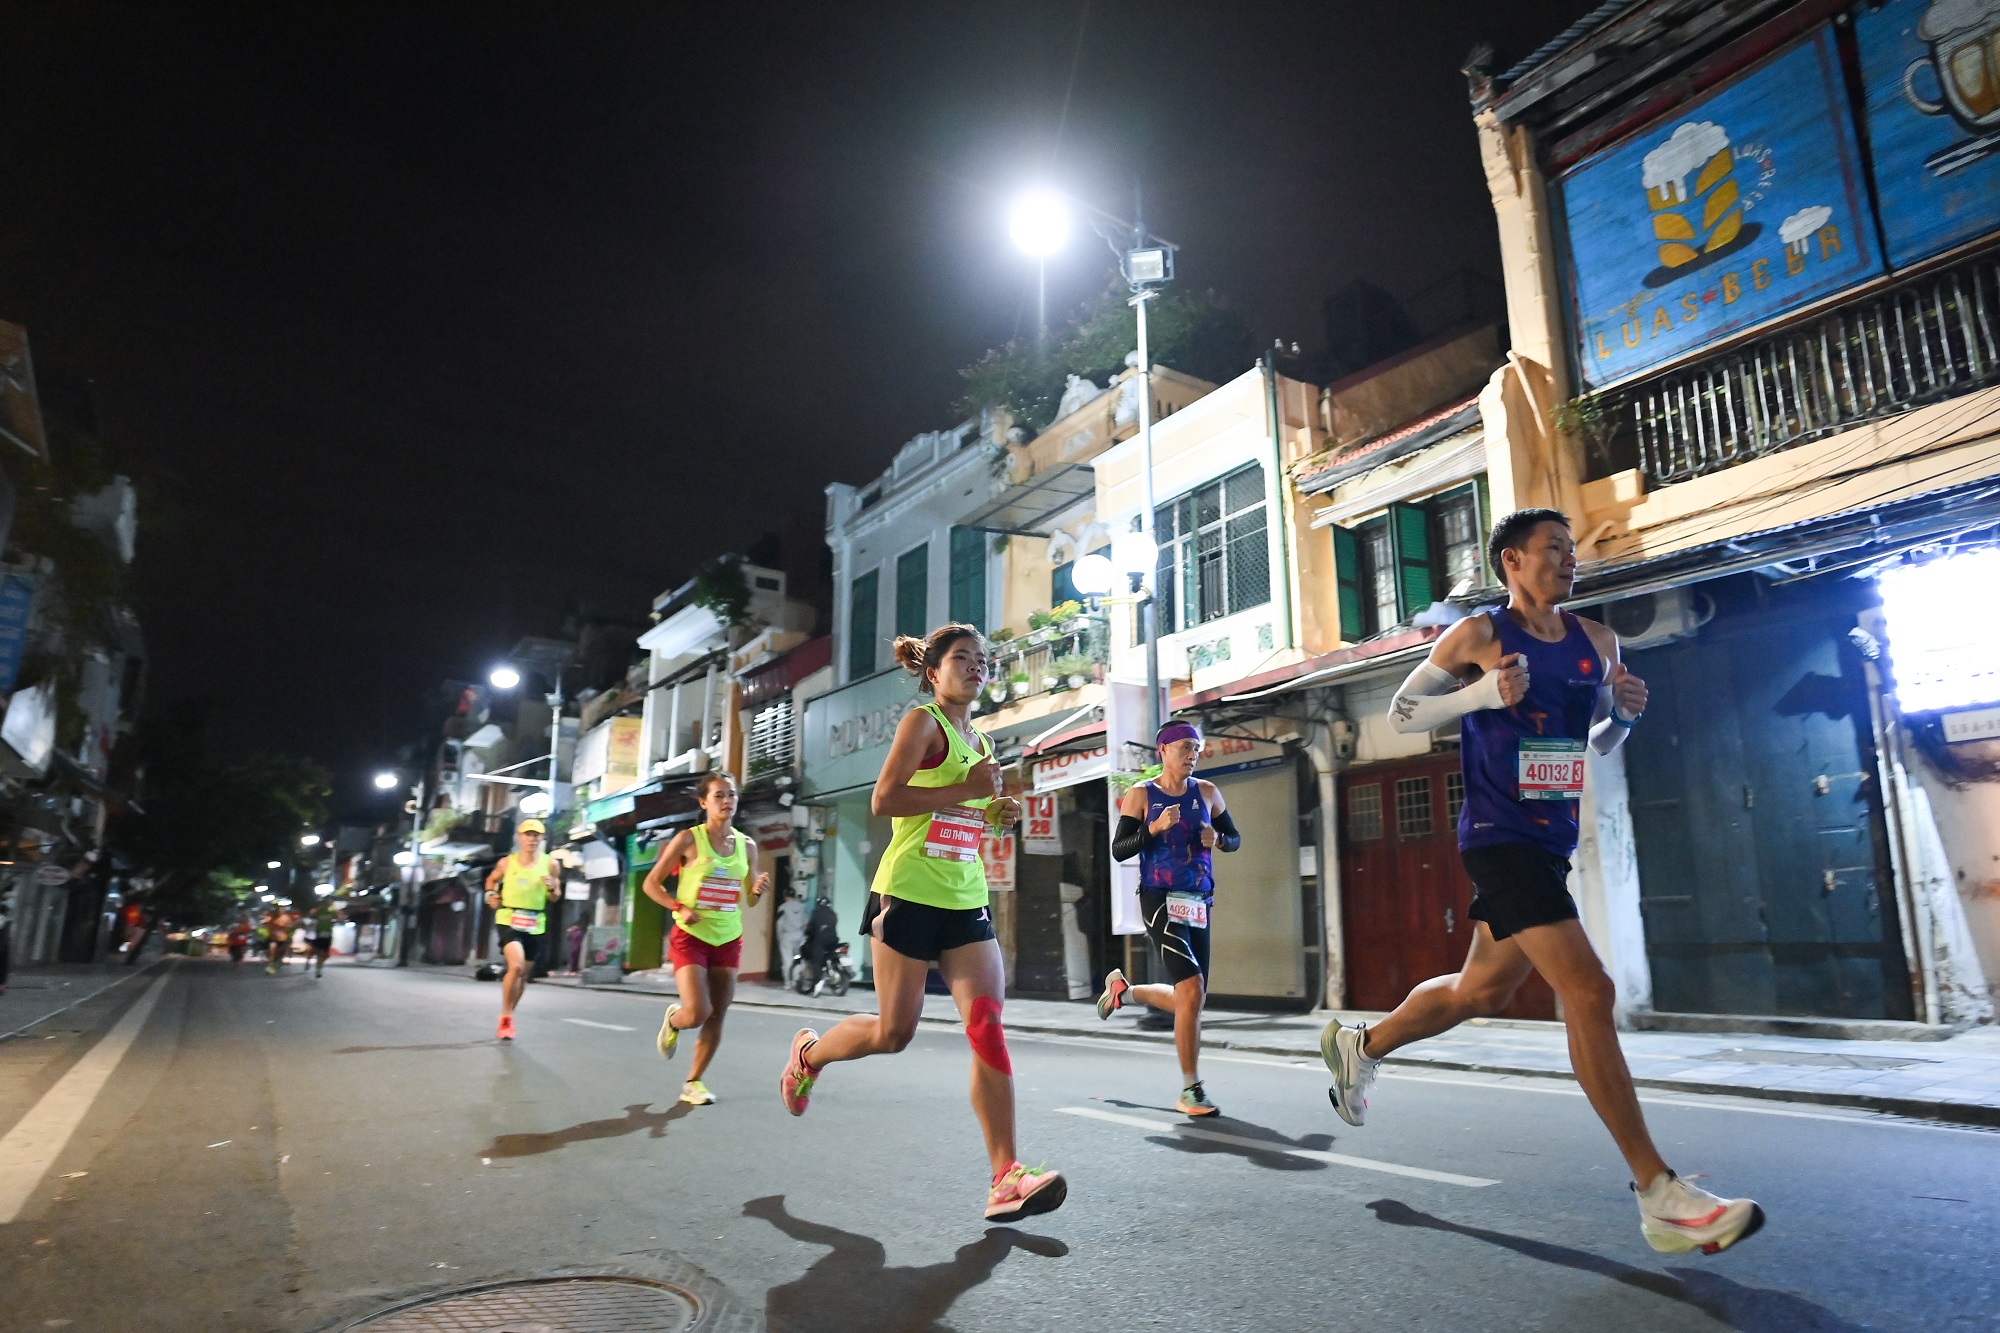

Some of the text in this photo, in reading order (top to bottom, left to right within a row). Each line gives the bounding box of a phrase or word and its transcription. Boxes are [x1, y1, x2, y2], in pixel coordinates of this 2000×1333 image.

[1596, 225, 1842, 359] LUAS BEER
[1525, 763, 1583, 782] 40132 3
[1029, 820, 1051, 834] 28
